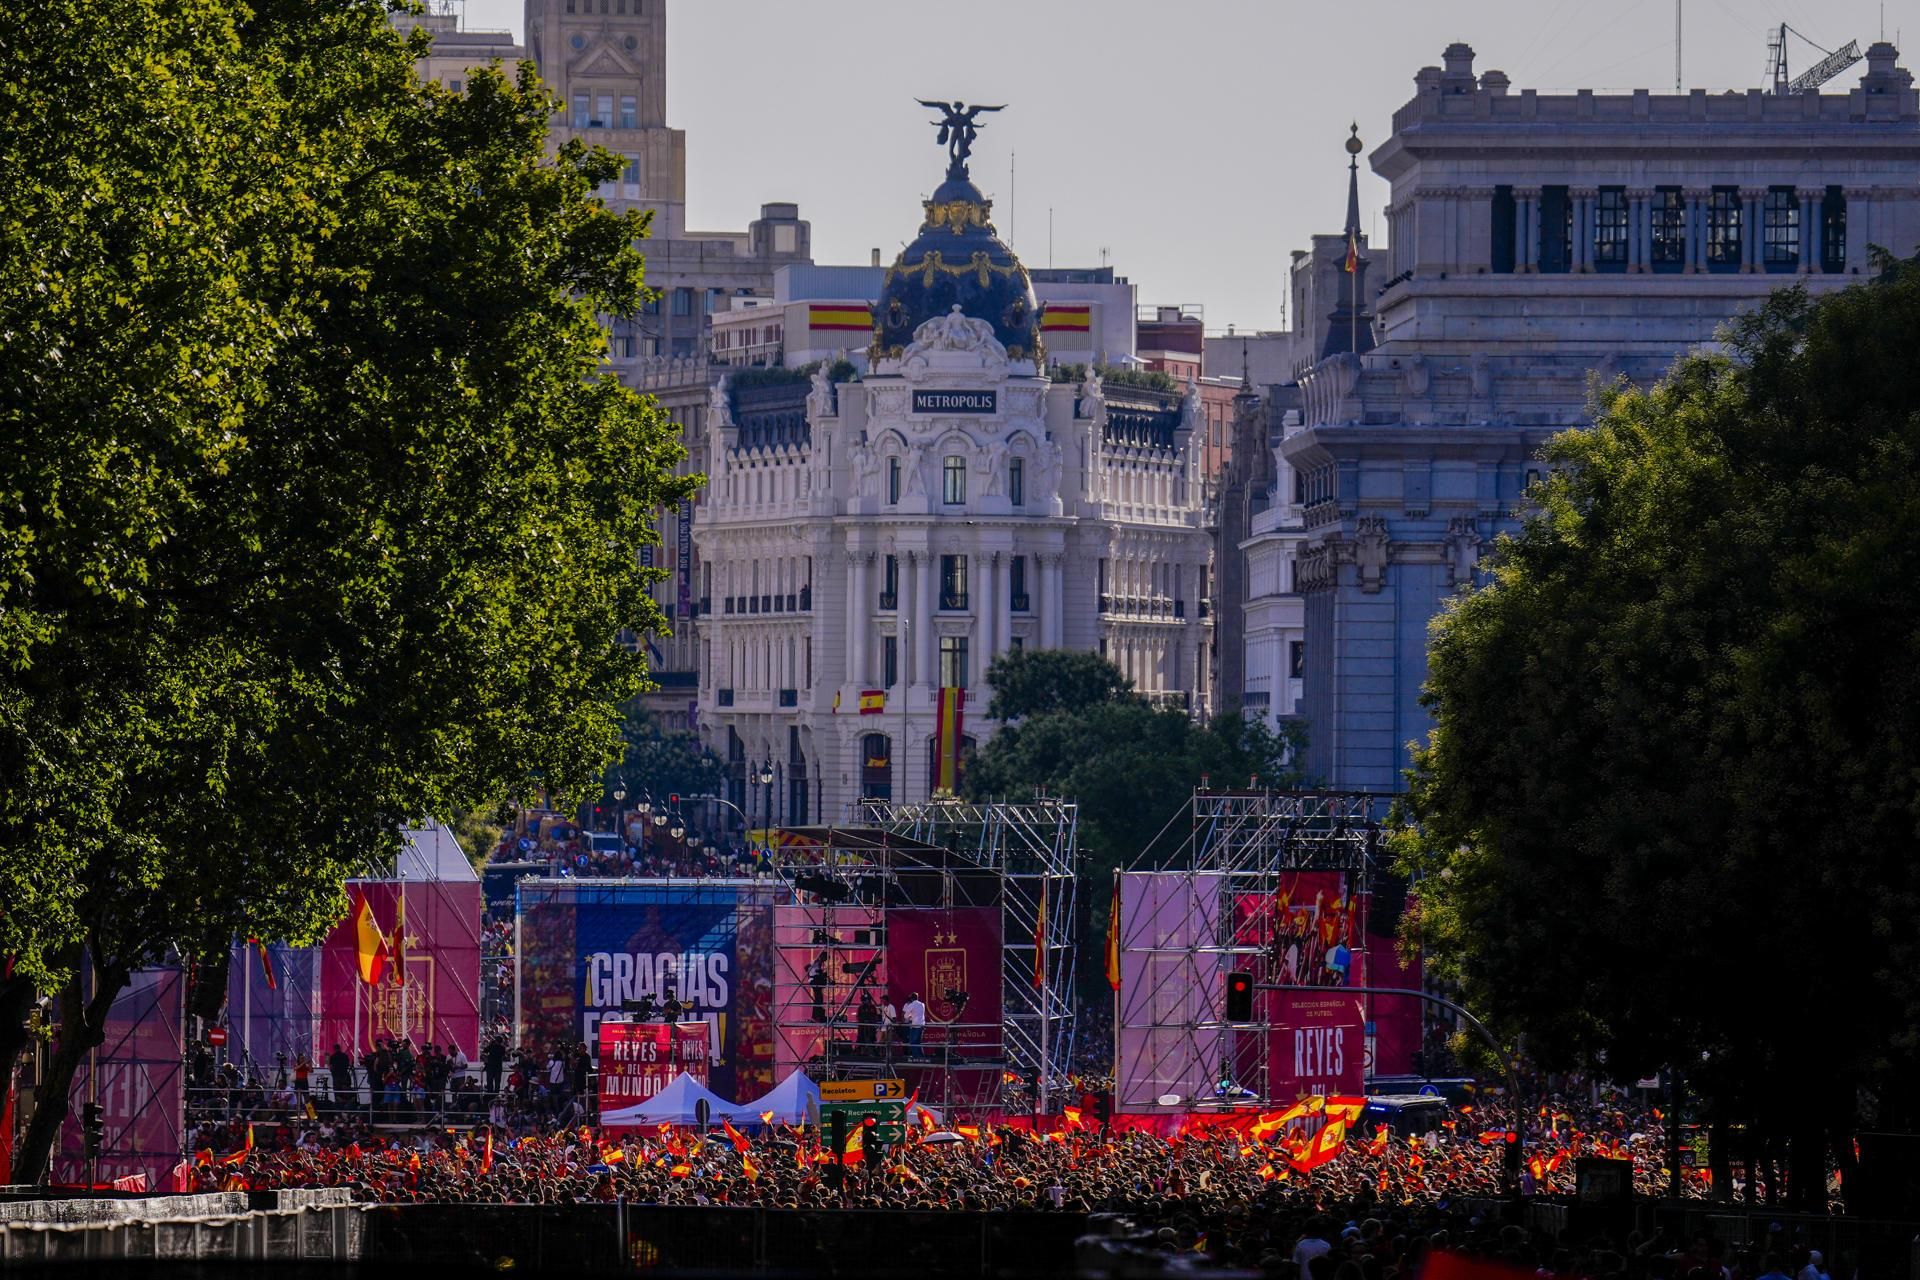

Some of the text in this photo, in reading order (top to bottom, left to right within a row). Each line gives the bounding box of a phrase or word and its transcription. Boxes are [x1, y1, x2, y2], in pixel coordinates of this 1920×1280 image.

[917, 395, 993, 408] METROPOLIS
[614, 1041, 656, 1061] REYES
[683, 1040, 704, 1060] REYES
[1295, 1027, 1344, 1077] REYES
[628, 1063, 641, 1075] DEL
[606, 1075, 662, 1097] MUNDO
